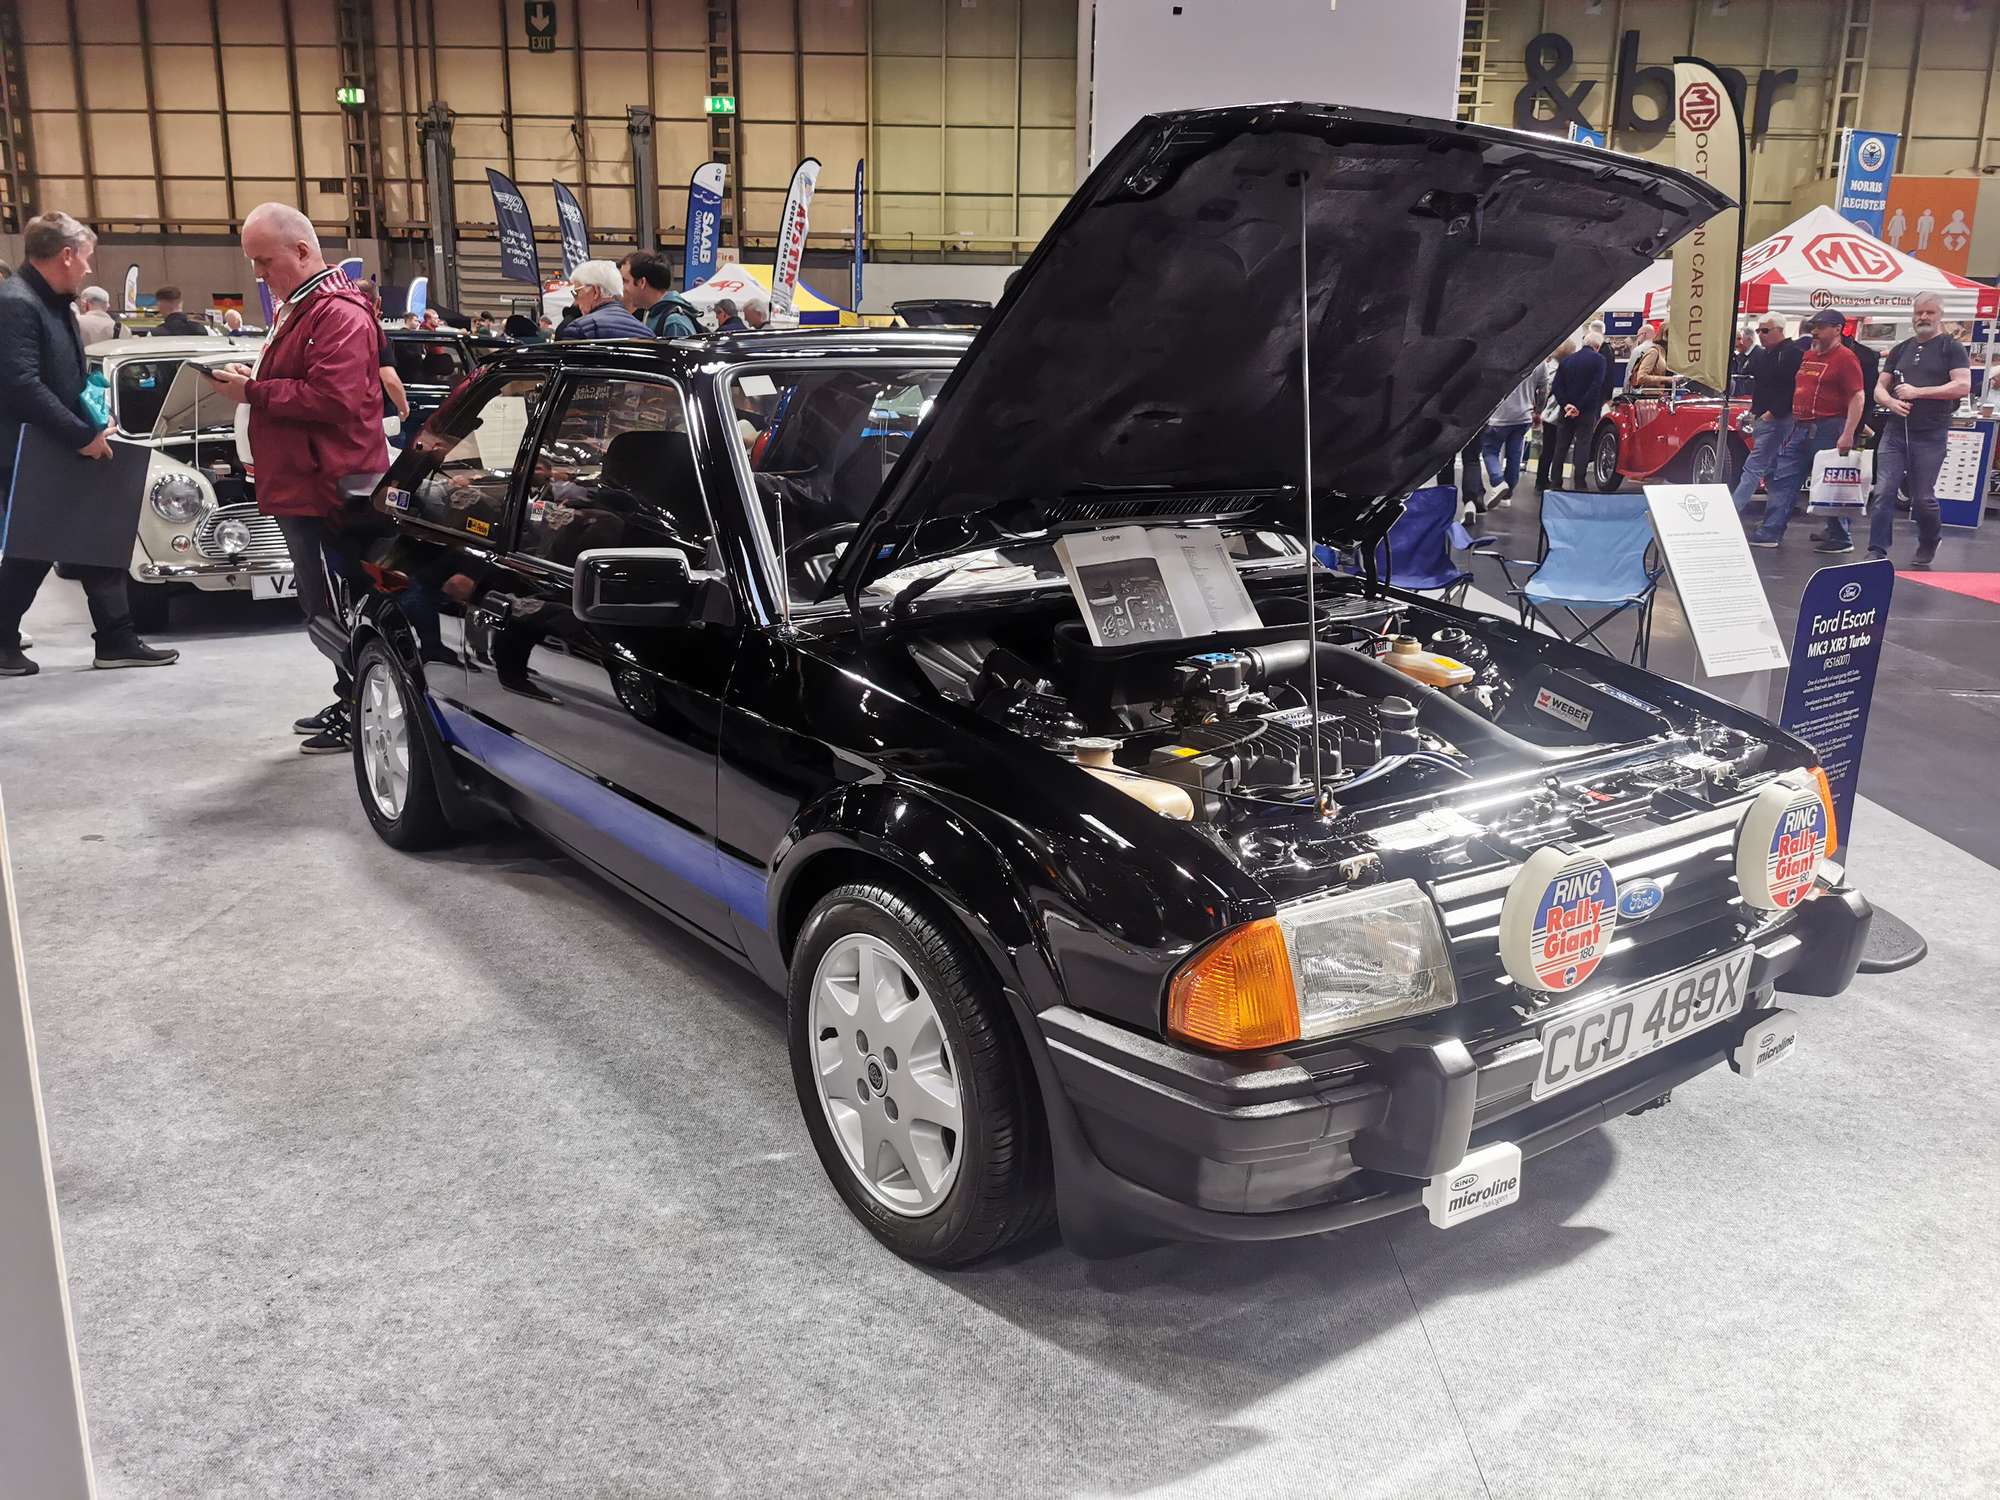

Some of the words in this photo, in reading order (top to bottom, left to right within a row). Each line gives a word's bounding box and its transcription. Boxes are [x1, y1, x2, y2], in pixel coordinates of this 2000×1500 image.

[532, 36, 552, 49] EXIT
[1616, 29, 1798, 135] br
[1683, 86, 1717, 130] MG
[1693, 133, 1708, 246] OCTN
[1850, 179, 1883, 193] MORRIS
[1842, 197, 1886, 211] REGISTER
[692, 210, 703, 246] OWNERS
[699, 211, 715, 265] SAAB
[691, 247, 700, 266] CLUB
[784, 203, 809, 289] AUSTIN
[1812, 239, 1893, 277] MG
[778, 259, 787, 283] CLUB
[1690, 253, 1705, 299] CAR
[1811, 290, 1831, 308] MG
[1833, 294, 1870, 306] Octagon
[1873, 295, 1890, 306] Car
[1891, 295, 1913, 306] Club
[1687, 305, 1703, 363] CLUB
[1102, 534, 1120, 543] Engine
[1841, 585, 1859, 599] Ford
[1811, 611, 1841, 636] Ford
[1841, 607, 1876, 631] Escort
[1807, 640, 1829, 659] MK3
[1829, 635, 1848, 654] XR3
[1848, 632, 1871, 649] Turbo
[1551, 697, 1589, 723] WEBER
[1783, 805, 1819, 834] RING
[1778, 828, 1819, 859] Rally
[1775, 853, 1815, 881] Giant
[1552, 870, 1602, 906] RING
[1625, 888, 1657, 914] Ford
[1546, 896, 1604, 935] Rally
[1543, 926, 1601, 960] Giant
[1579, 945, 1595, 960] 180
[1544, 1002, 1634, 1085] CGD
[1642, 955, 1747, 1042] 489X
[1756, 1034, 1796, 1065] microline
[1448, 1177, 1518, 1213] microline
[1454, 1176, 1476, 1189] RING
